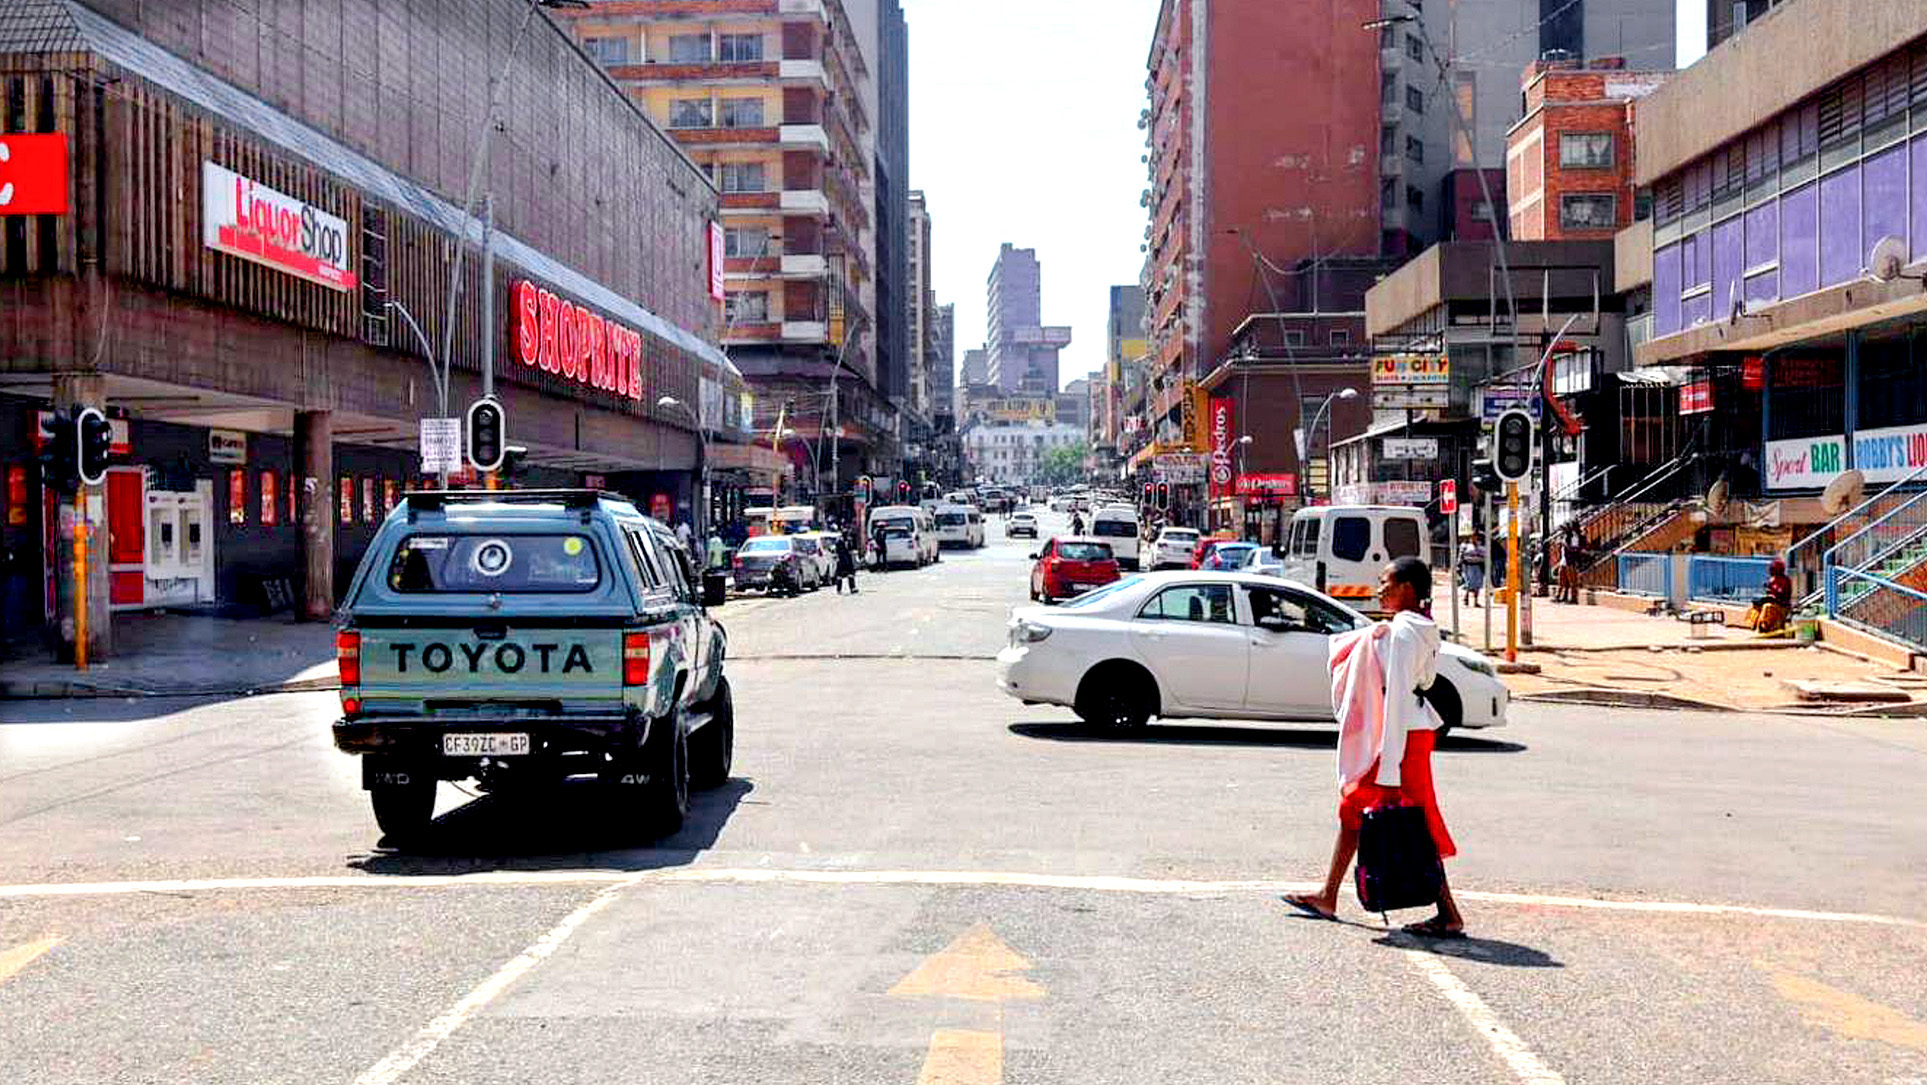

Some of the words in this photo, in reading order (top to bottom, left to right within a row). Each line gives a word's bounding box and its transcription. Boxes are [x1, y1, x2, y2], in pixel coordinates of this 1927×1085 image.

[517, 279, 642, 401] SHOPRITE
[1811, 443, 1840, 472] BAR
[1907, 432, 1927, 467] LIQ
[389, 643, 593, 673] TOYOTA
[511, 736, 528, 752] GP
